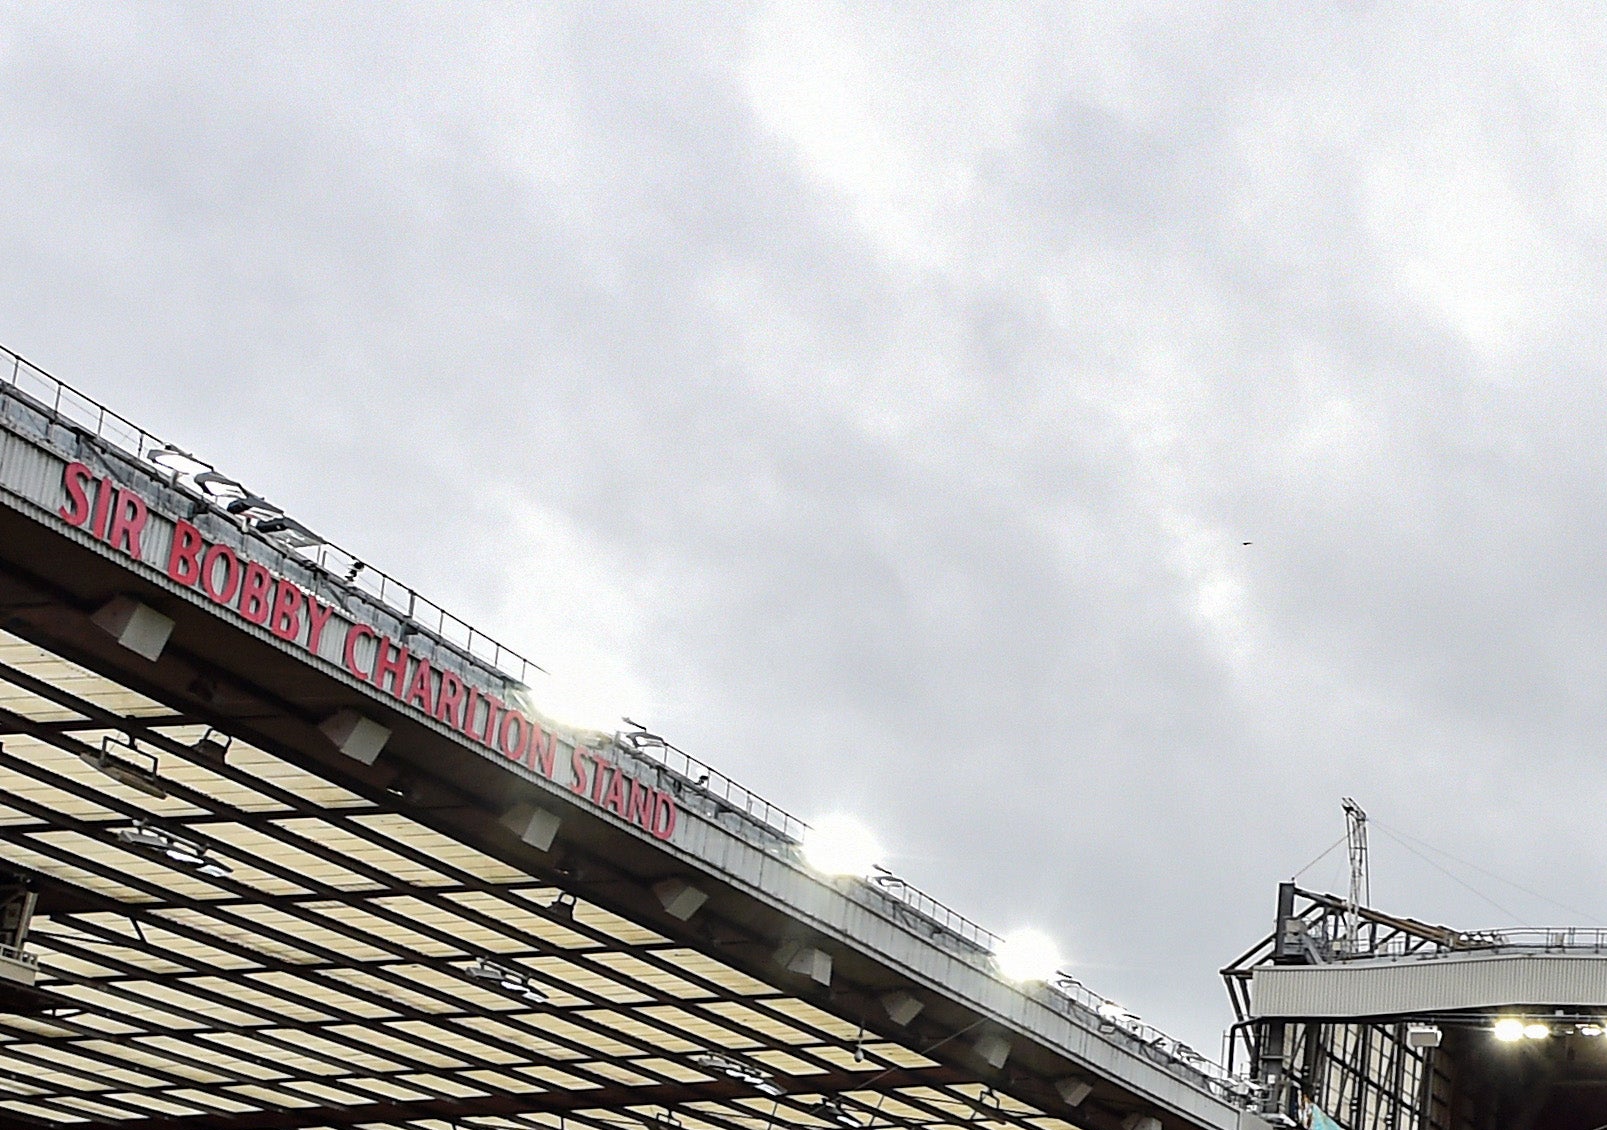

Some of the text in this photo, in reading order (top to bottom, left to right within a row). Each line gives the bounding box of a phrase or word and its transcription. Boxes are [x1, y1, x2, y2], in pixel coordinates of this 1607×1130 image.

[58, 460, 677, 841] SIR BOBBY CHARLTON STAND
